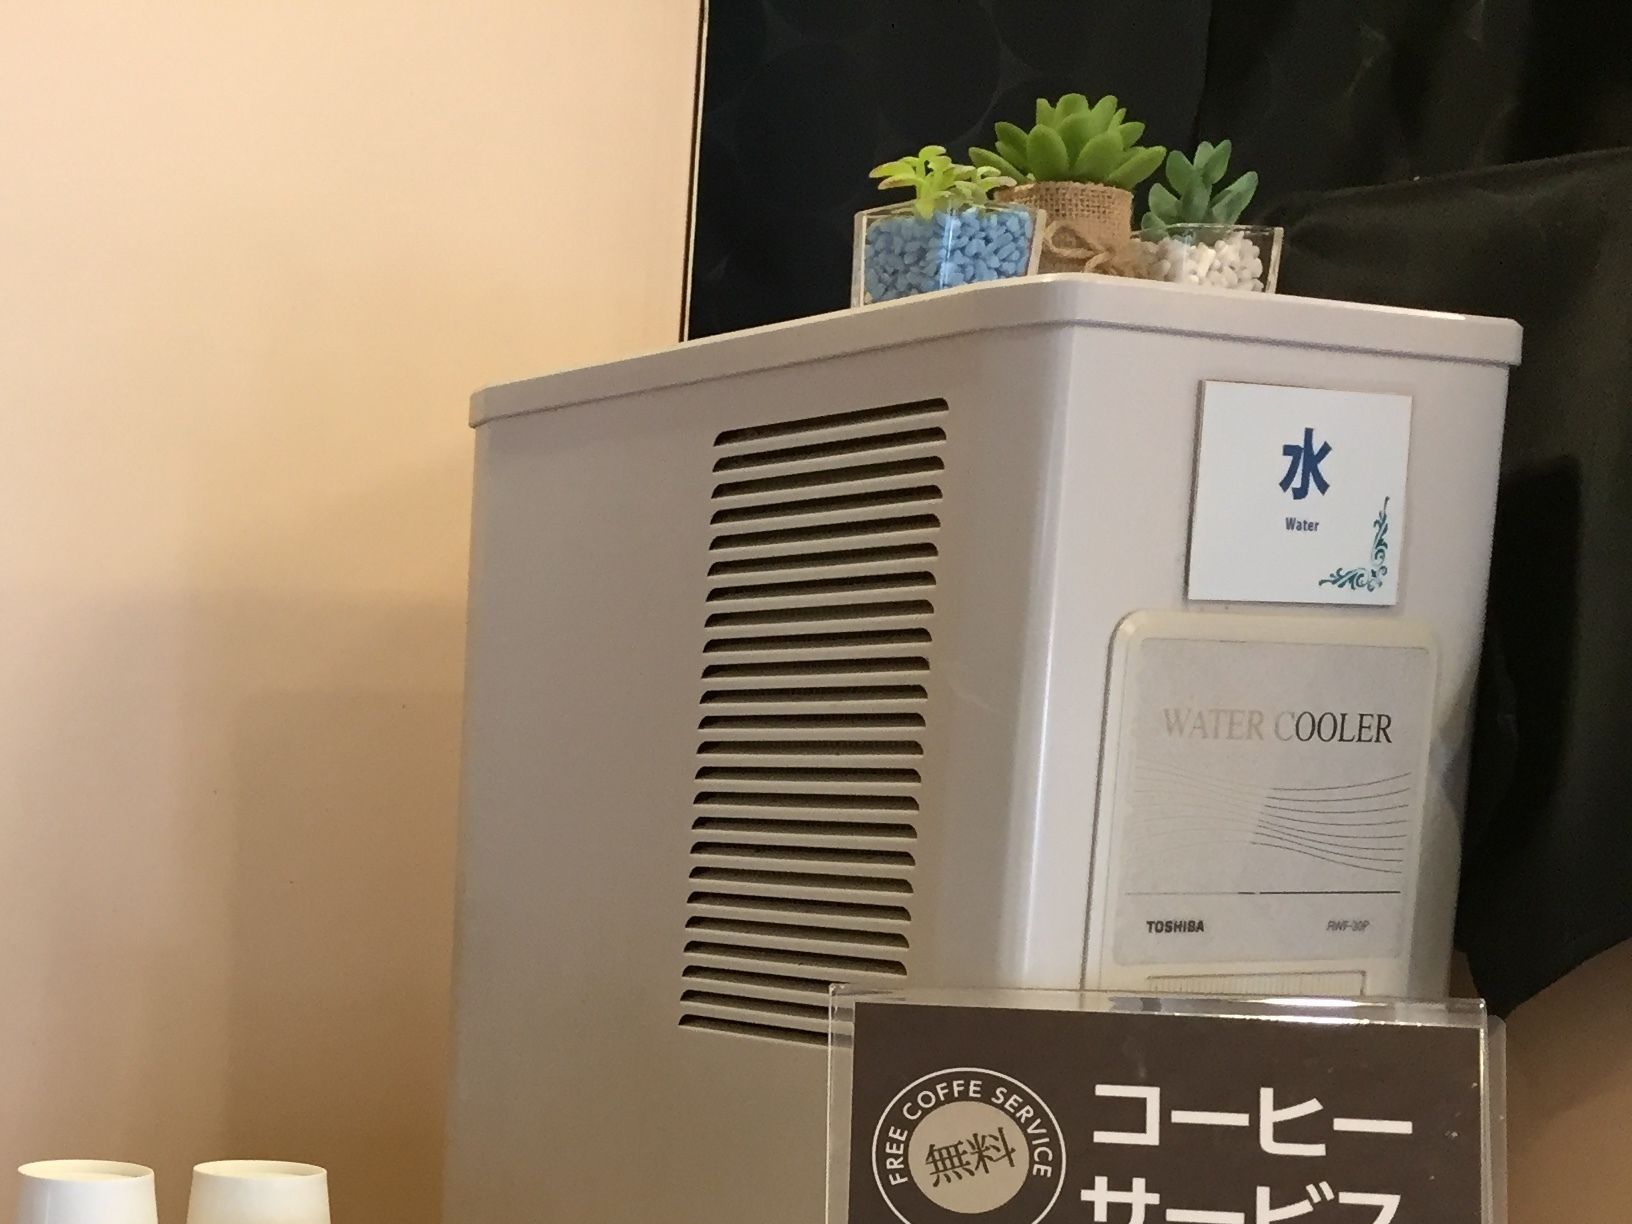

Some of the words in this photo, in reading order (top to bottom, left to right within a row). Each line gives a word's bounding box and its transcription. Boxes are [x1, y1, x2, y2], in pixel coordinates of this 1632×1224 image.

[1279, 427, 1332, 500] 水
[1285, 516, 1320, 533] Water
[1163, 706, 1265, 743] WATER
[1273, 709, 1393, 745] COOLER
[1146, 920, 1205, 934] TOSHIBA
[885, 1126, 909, 1186] FREE
[902, 1079, 983, 1121] COFFE
[990, 1086, 1053, 1179] SERVICE
[1092, 1083, 1414, 1158] コーヒー
[925, 1126, 1016, 1188] 無料
